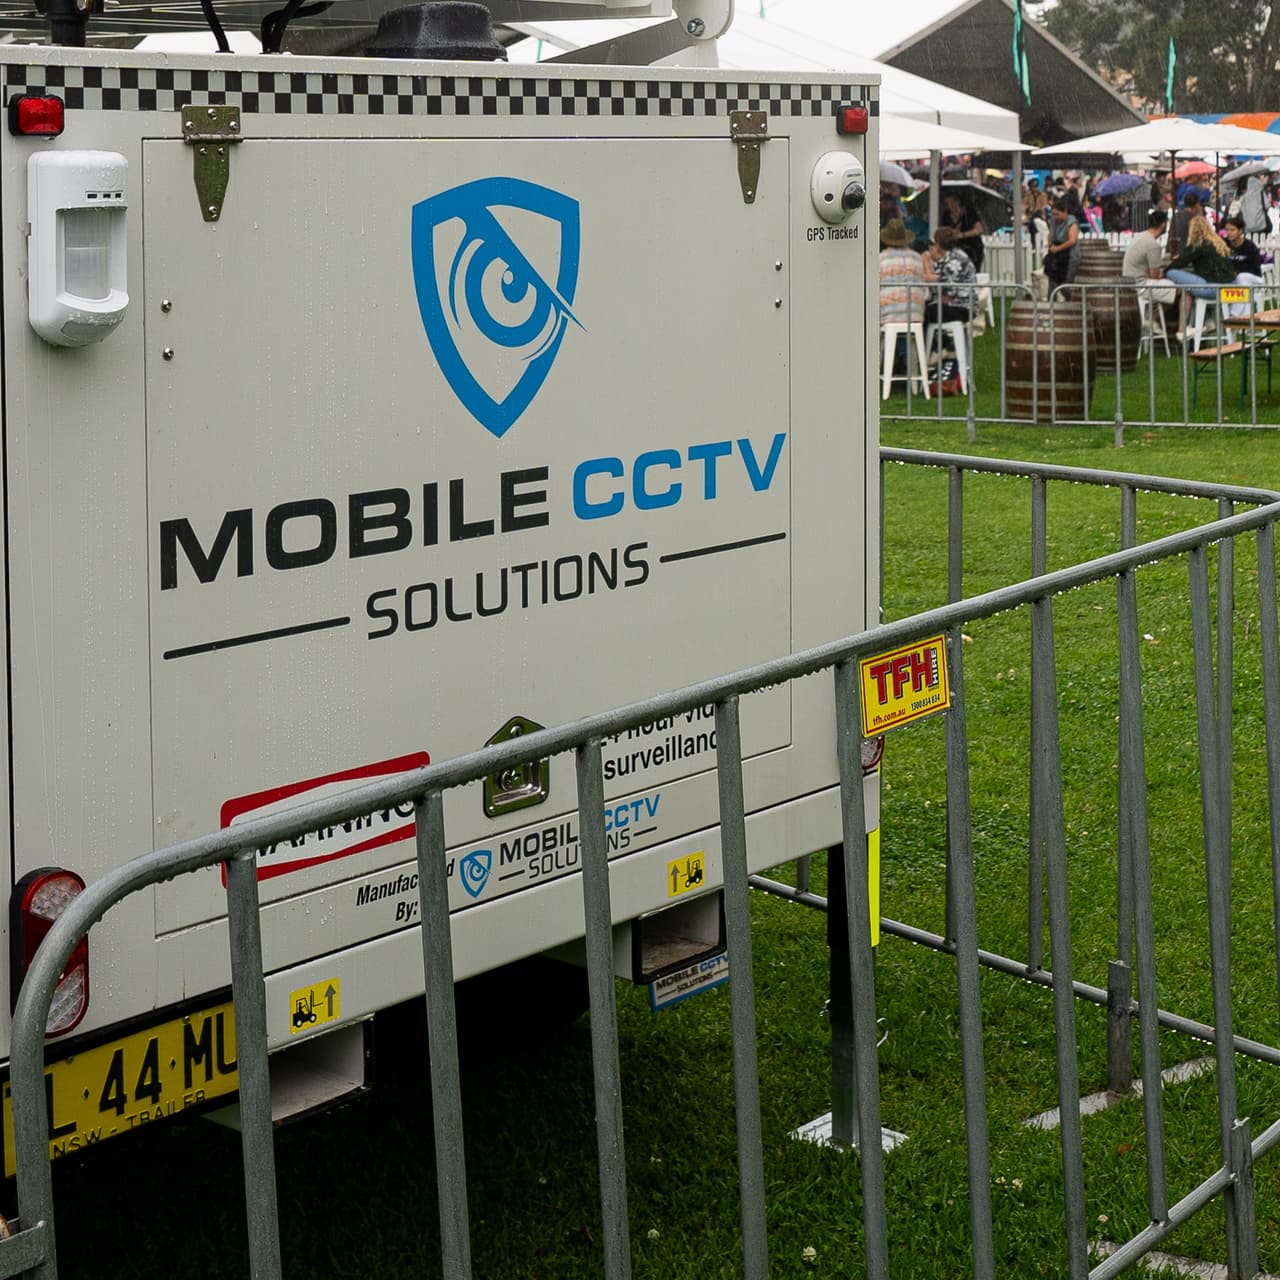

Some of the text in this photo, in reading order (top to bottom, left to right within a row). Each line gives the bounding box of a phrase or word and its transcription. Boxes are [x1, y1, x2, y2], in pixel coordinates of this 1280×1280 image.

[806, 224, 859, 241] GPS Tracked
[159, 432, 787, 592] MOBILE CCTV
[366, 541, 650, 641] SOLUTIONS
[870, 647, 933, 705] TFH
[872, 708, 906, 726] tfh.com.au
[603, 729, 718, 781] surveillanc
[500, 822, 579, 866] MOBIL
[528, 827, 631, 880] SOLUNS
[356, 857, 455, 907] Manufacd
[395, 901, 418, 922] By:
[656, 965, 699, 991] MOBILE
[677, 971, 714, 993] SOLUTIONS
[51, 1126, 103, 1159] NSW
[124, 1089, 207, 1130] TRAILER
